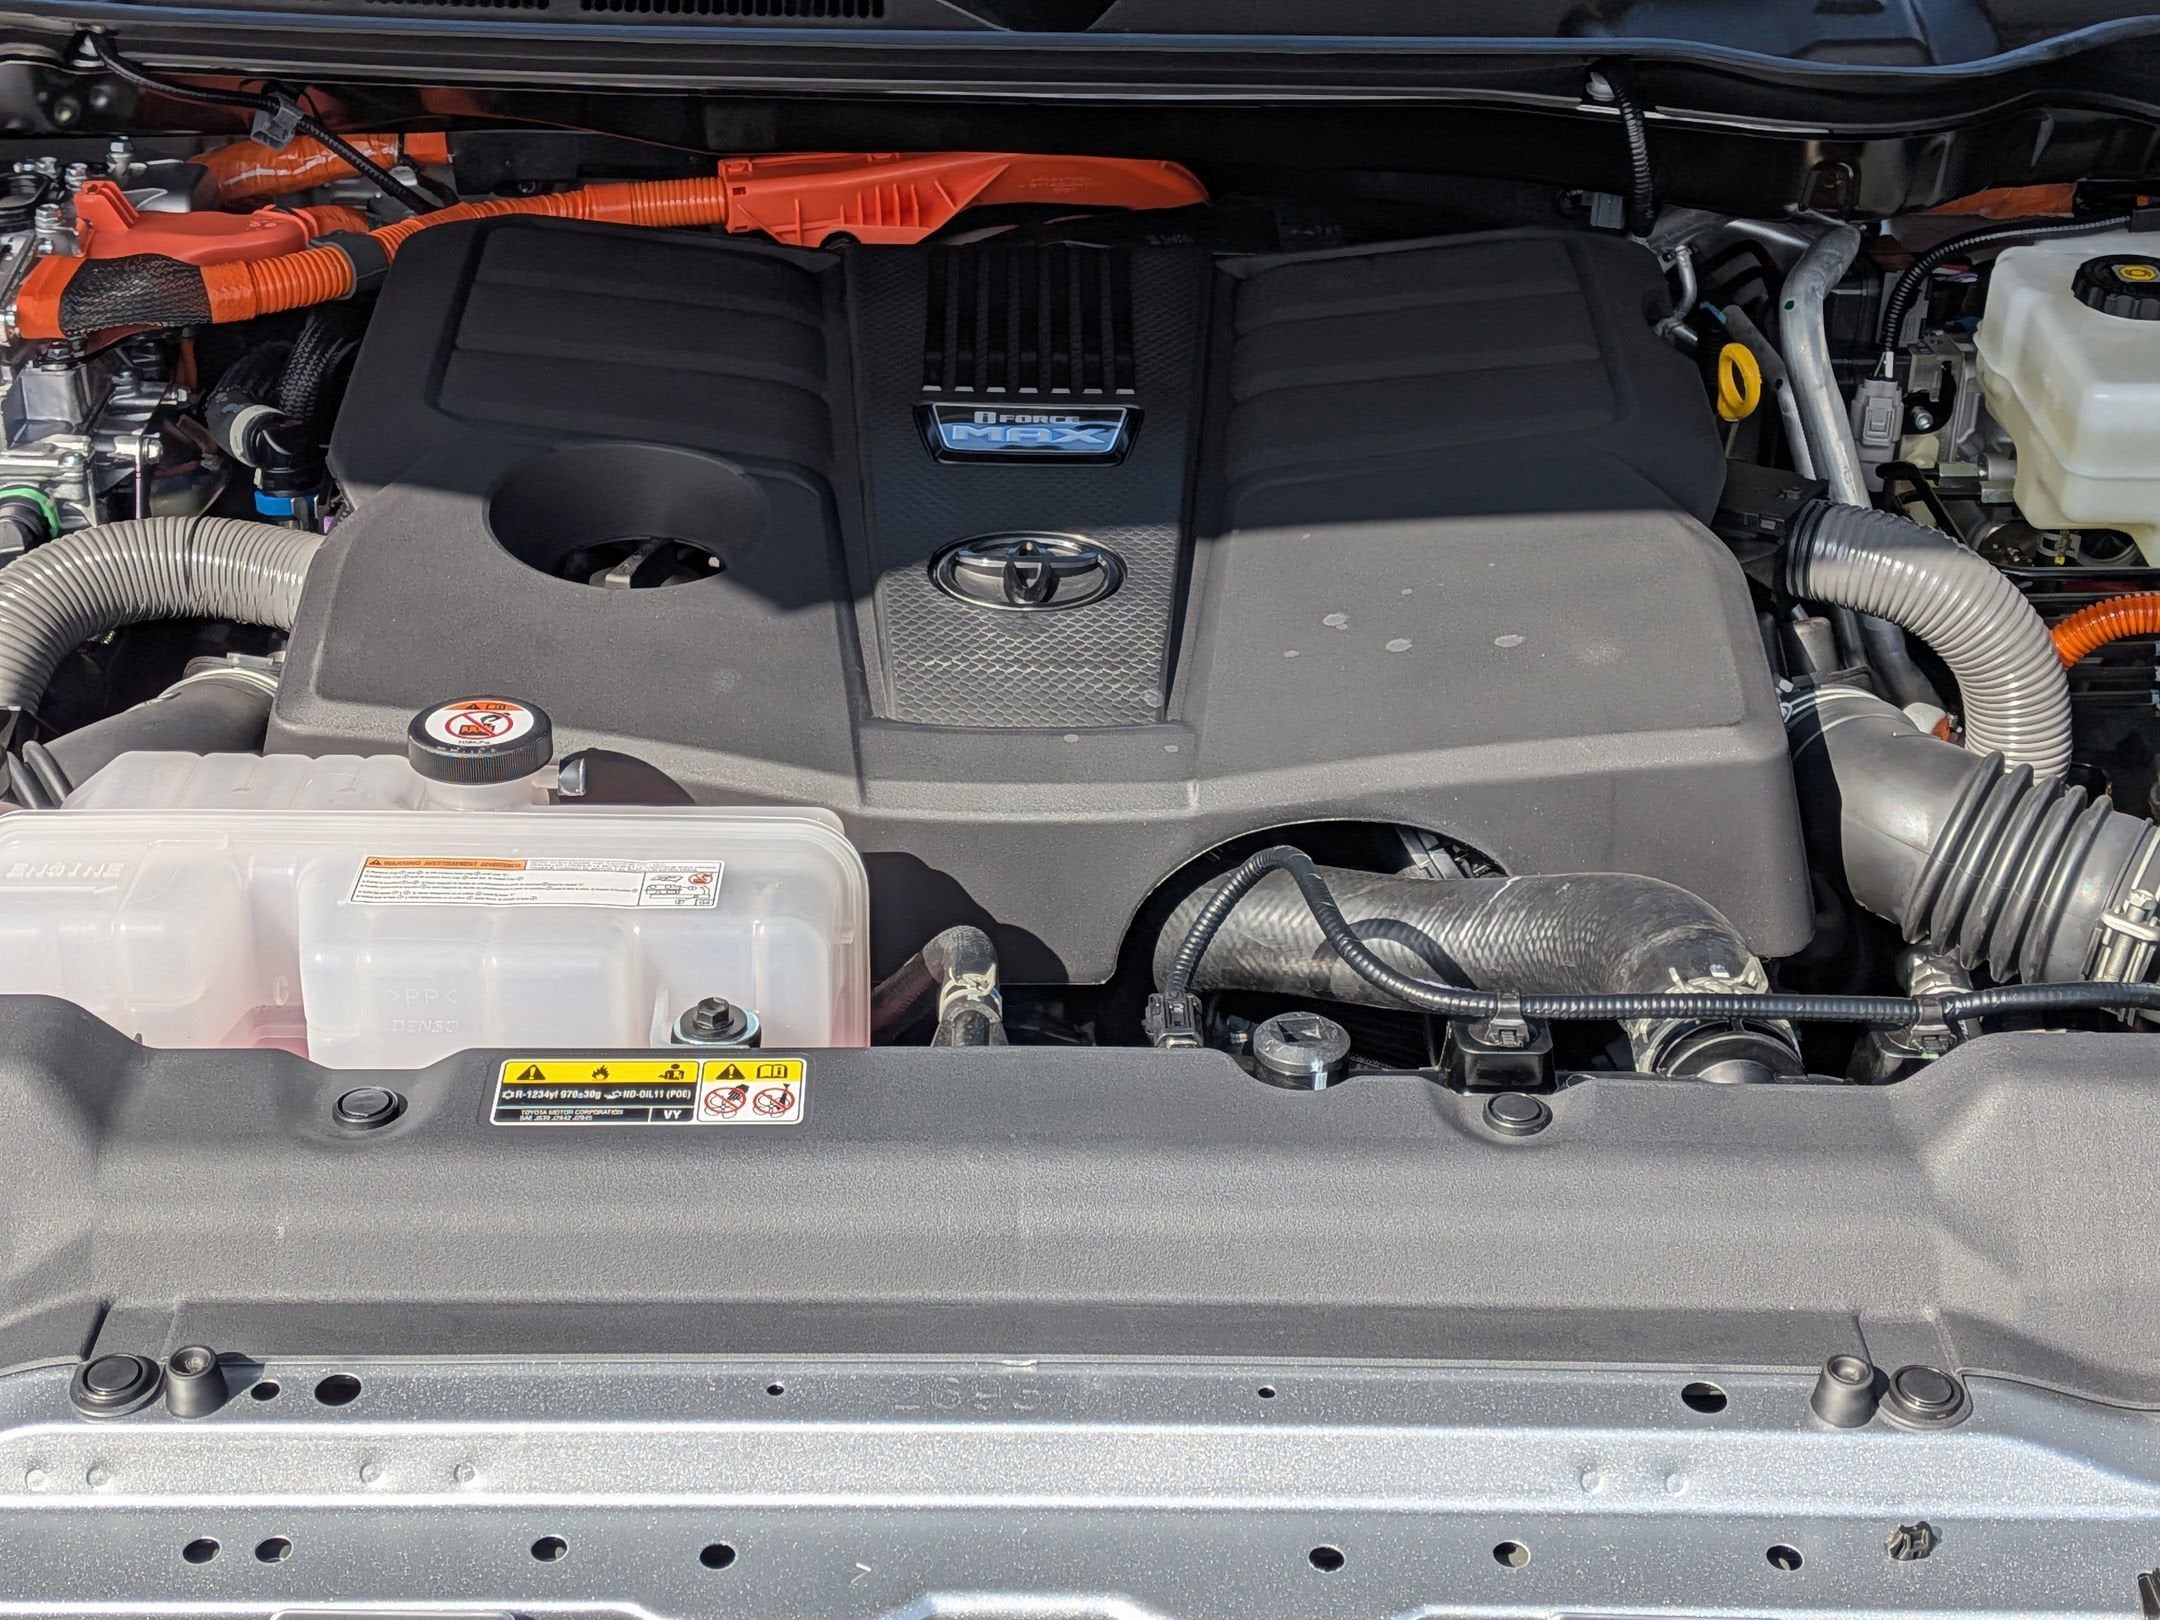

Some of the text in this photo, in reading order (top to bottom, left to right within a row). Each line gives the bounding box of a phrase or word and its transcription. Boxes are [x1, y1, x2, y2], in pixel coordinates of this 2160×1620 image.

[1000, 414, 1081, 424] FORCE
[952, 425, 1105, 444] MAX
[6, 862, 124, 878] ENGINE
[391, 1019, 460, 1033] DENSO
[515, 1090, 558, 1099] R-1234yf
[666, 1089, 691, 1099] (POE)
[664, 1110, 682, 1119] VY
